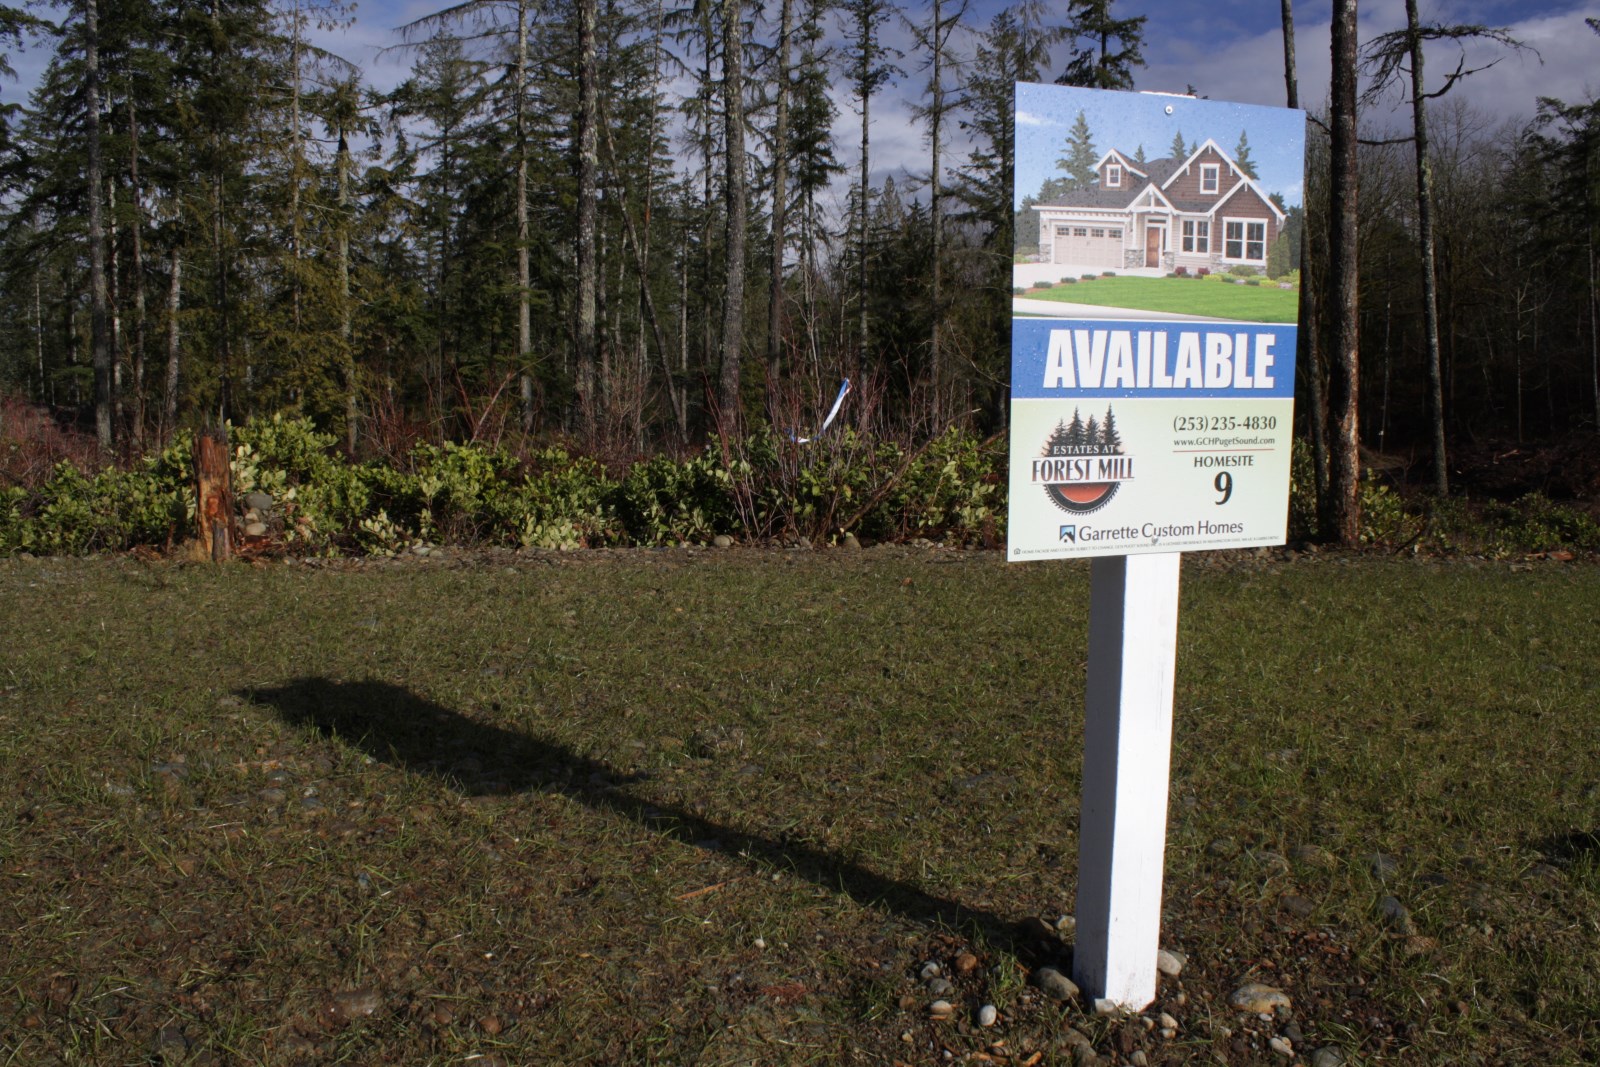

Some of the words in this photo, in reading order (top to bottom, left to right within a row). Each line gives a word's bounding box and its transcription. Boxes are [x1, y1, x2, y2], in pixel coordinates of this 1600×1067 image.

[1042, 328, 1276, 389] AVAILABLE
[1053, 444, 1100, 455] ESTATES
[1102, 444, 1116, 454] AT
[1173, 436, 1276, 447] www.GCHPugetSound.com
[1032, 458, 1091, 482] FOREST
[1098, 457, 1135, 479] MILL
[1193, 455, 1255, 468] HOMESITE
[1214, 471, 1233, 505] 9
[1078, 527, 1139, 541] Garrette
[1141, 523, 1193, 539] Custom
[1197, 519, 1244, 535] Homes
